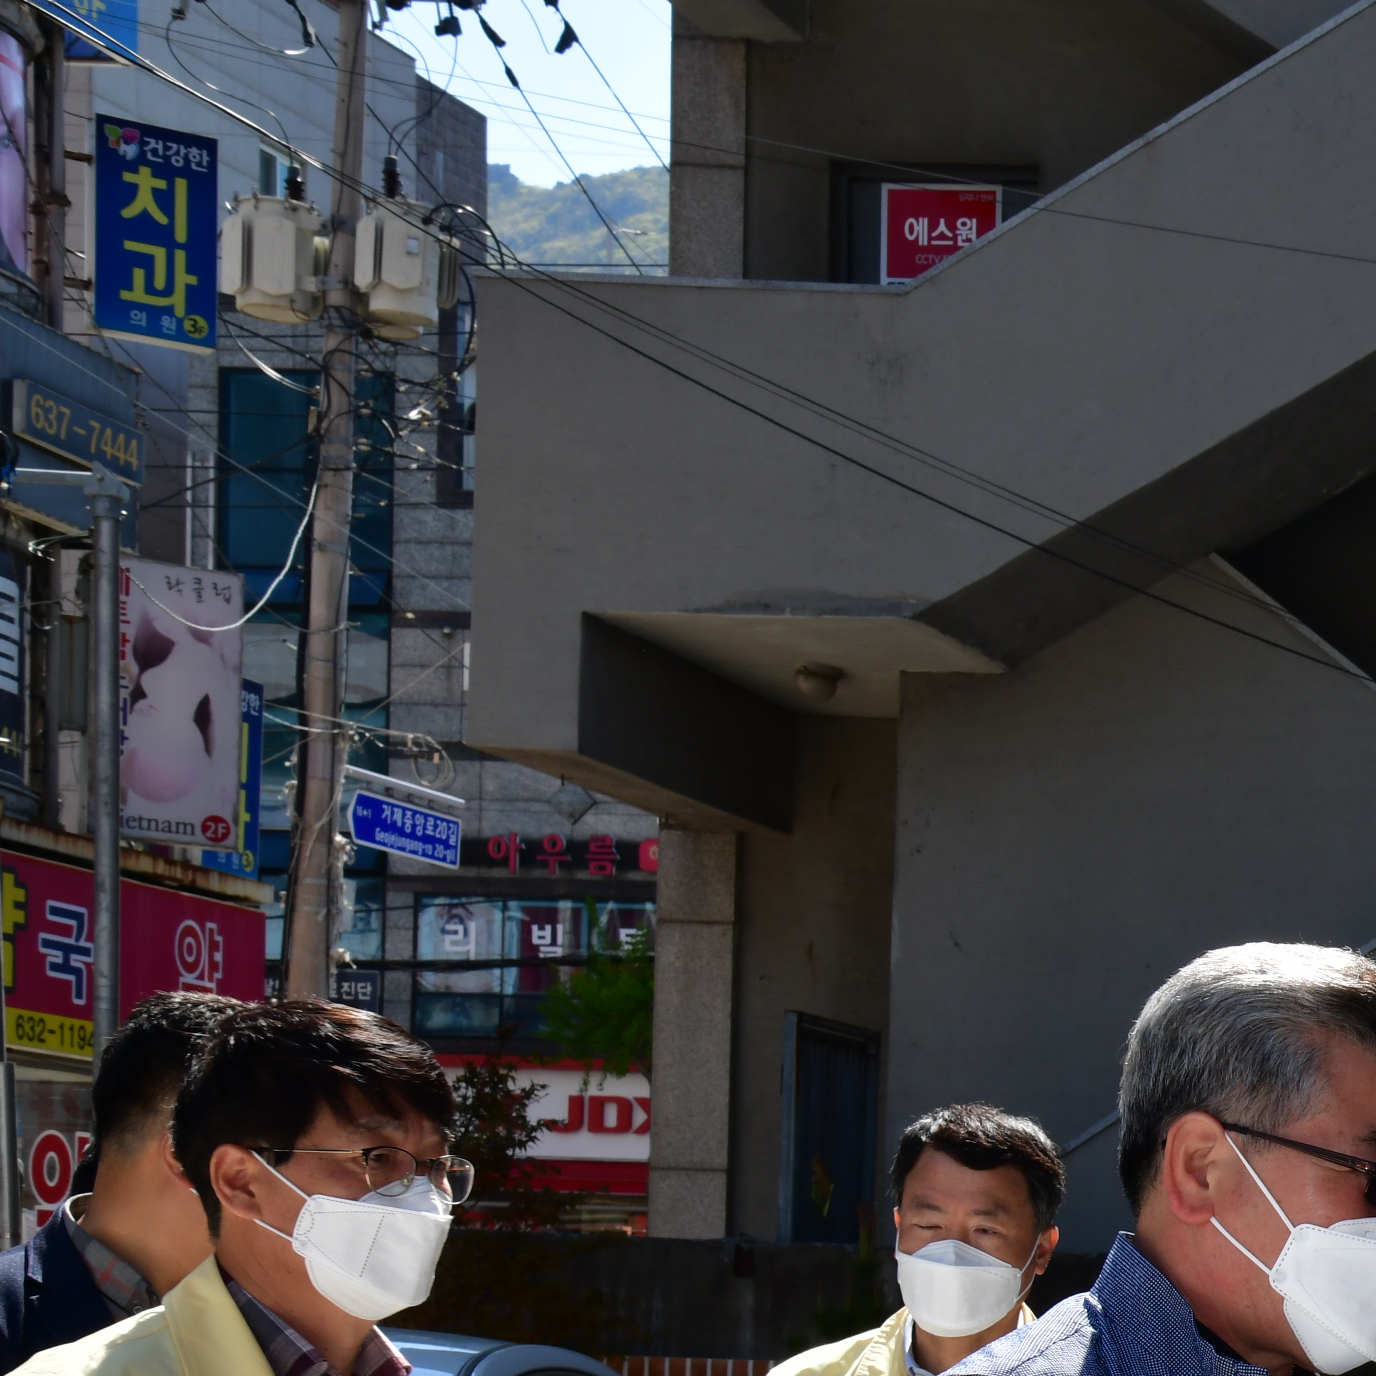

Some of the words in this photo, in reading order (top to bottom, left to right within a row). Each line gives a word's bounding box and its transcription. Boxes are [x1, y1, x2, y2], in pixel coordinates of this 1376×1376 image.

[143, 136, 210, 173] 건강한
[119, 165, 198, 318] 치과
[904, 216, 977, 247] 에스원
[129, 309, 177, 335] 의원
[30, 393, 139, 472] 637-7444
[120, 808, 196, 837] ietnam
[205, 821, 228, 839] 2F
[382, 804, 458, 846] 거제중앙로20길
[487, 832, 619, 876] 아우름
